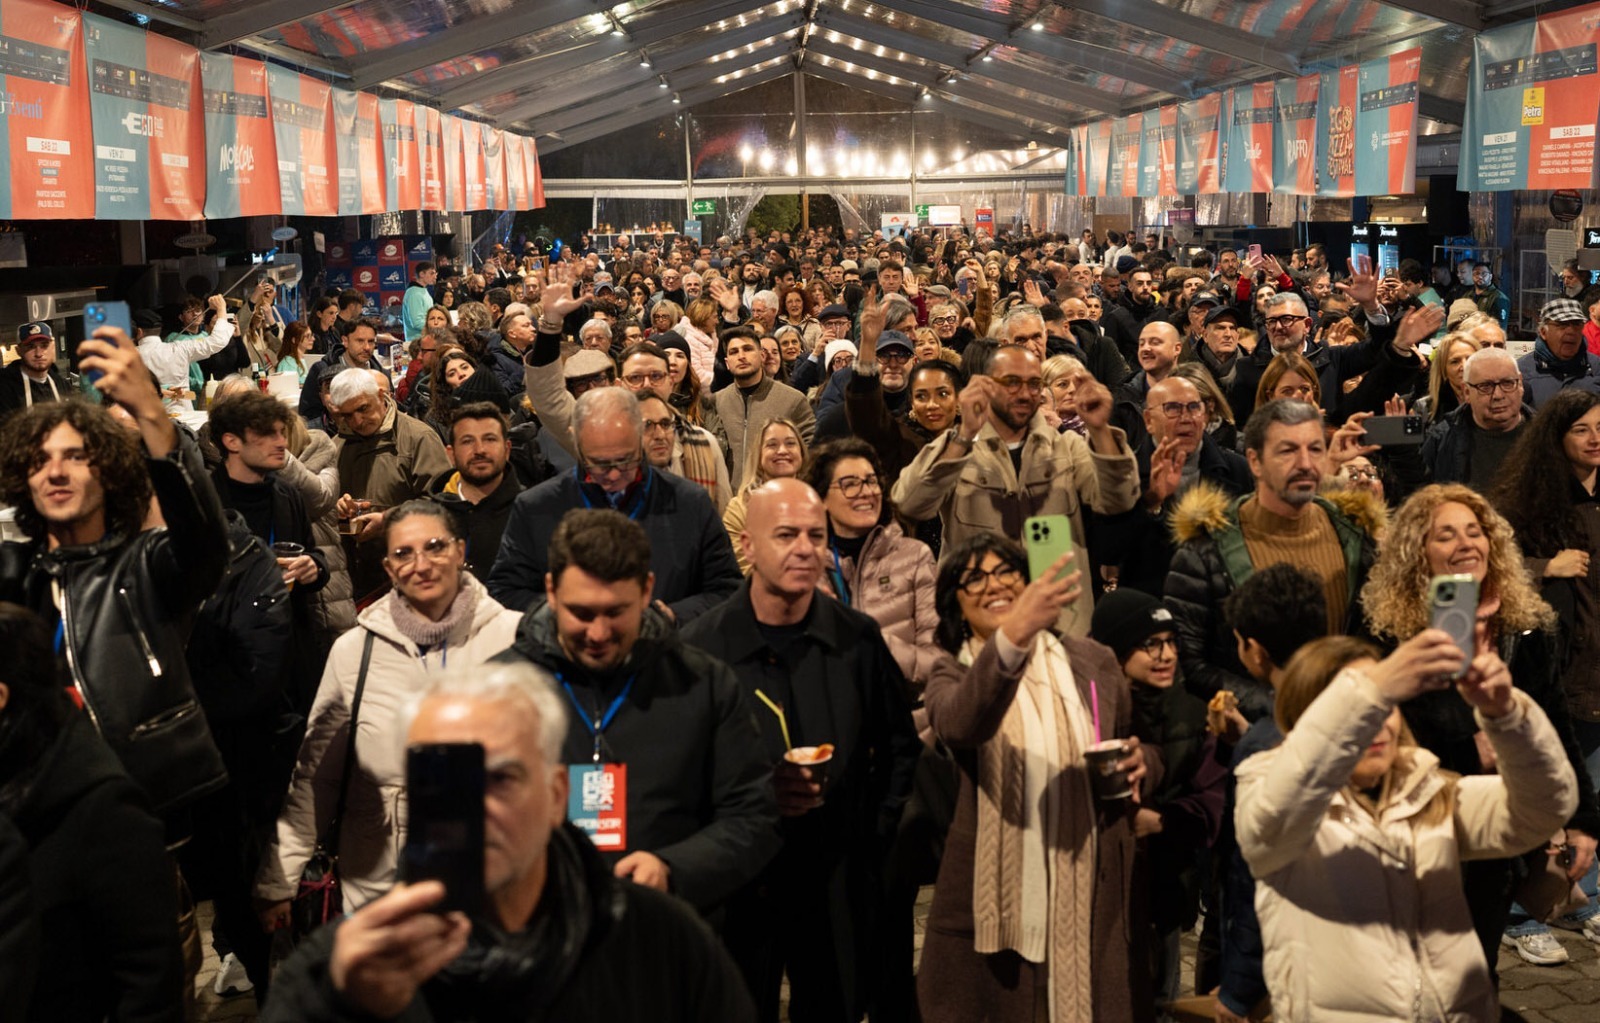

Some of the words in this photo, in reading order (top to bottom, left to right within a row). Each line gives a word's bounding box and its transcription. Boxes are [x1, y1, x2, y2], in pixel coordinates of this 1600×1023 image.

[1524, 105, 1542, 118] Petra
[1562, 128, 1573, 136] SAB
[1573, 127, 1580, 136] 22
[1287, 139, 1308, 168] RAFFO
